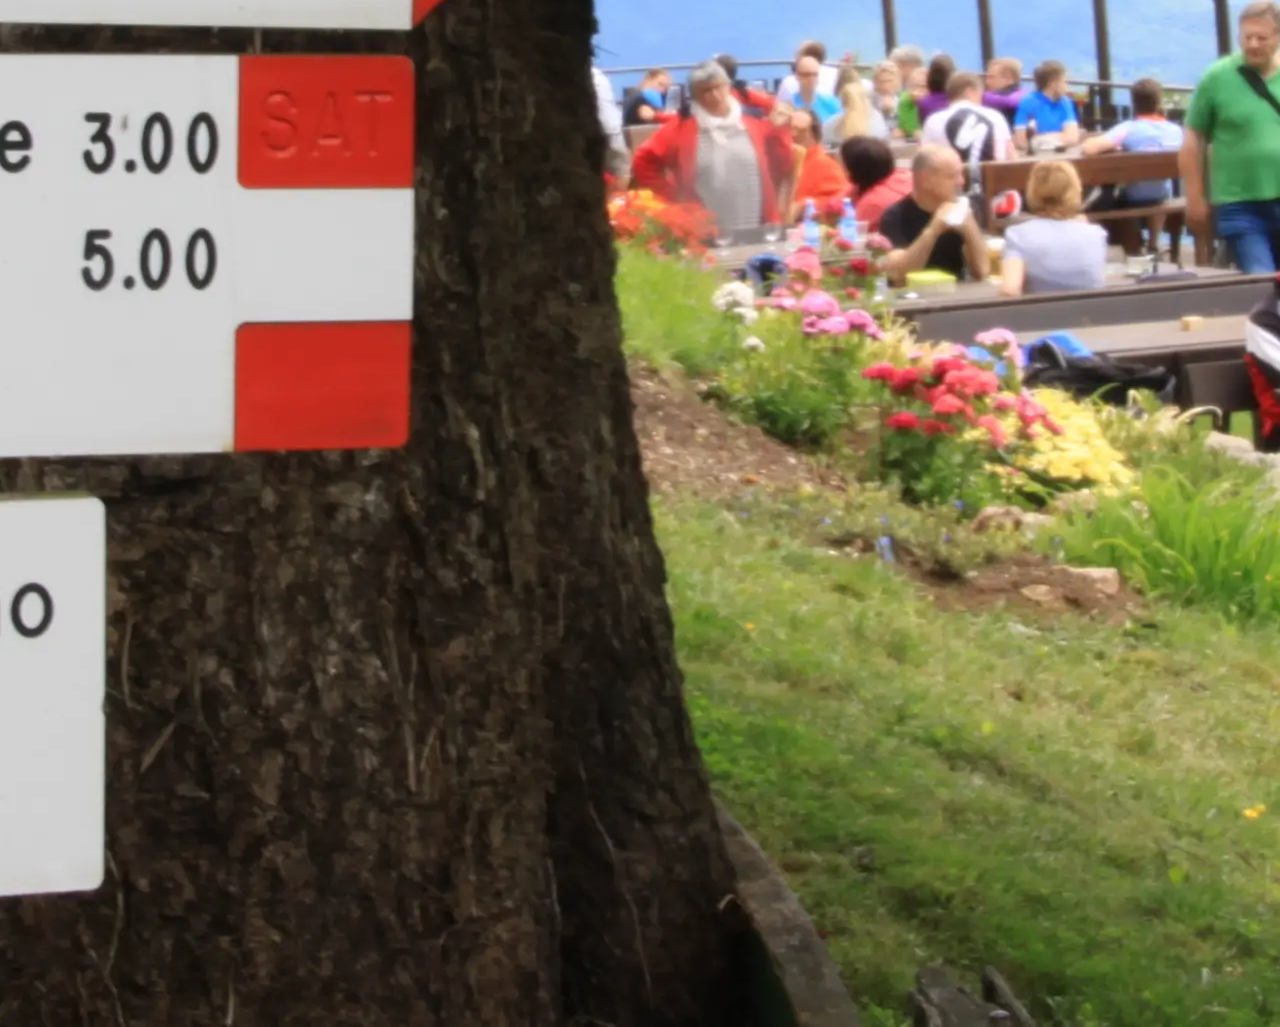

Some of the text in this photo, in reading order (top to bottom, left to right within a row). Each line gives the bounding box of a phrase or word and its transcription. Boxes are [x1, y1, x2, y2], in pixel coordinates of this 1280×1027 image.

[83, 111, 220, 177] 3.00
[259, 89, 394, 159] SAT
[81, 228, 218, 293] 5.00
